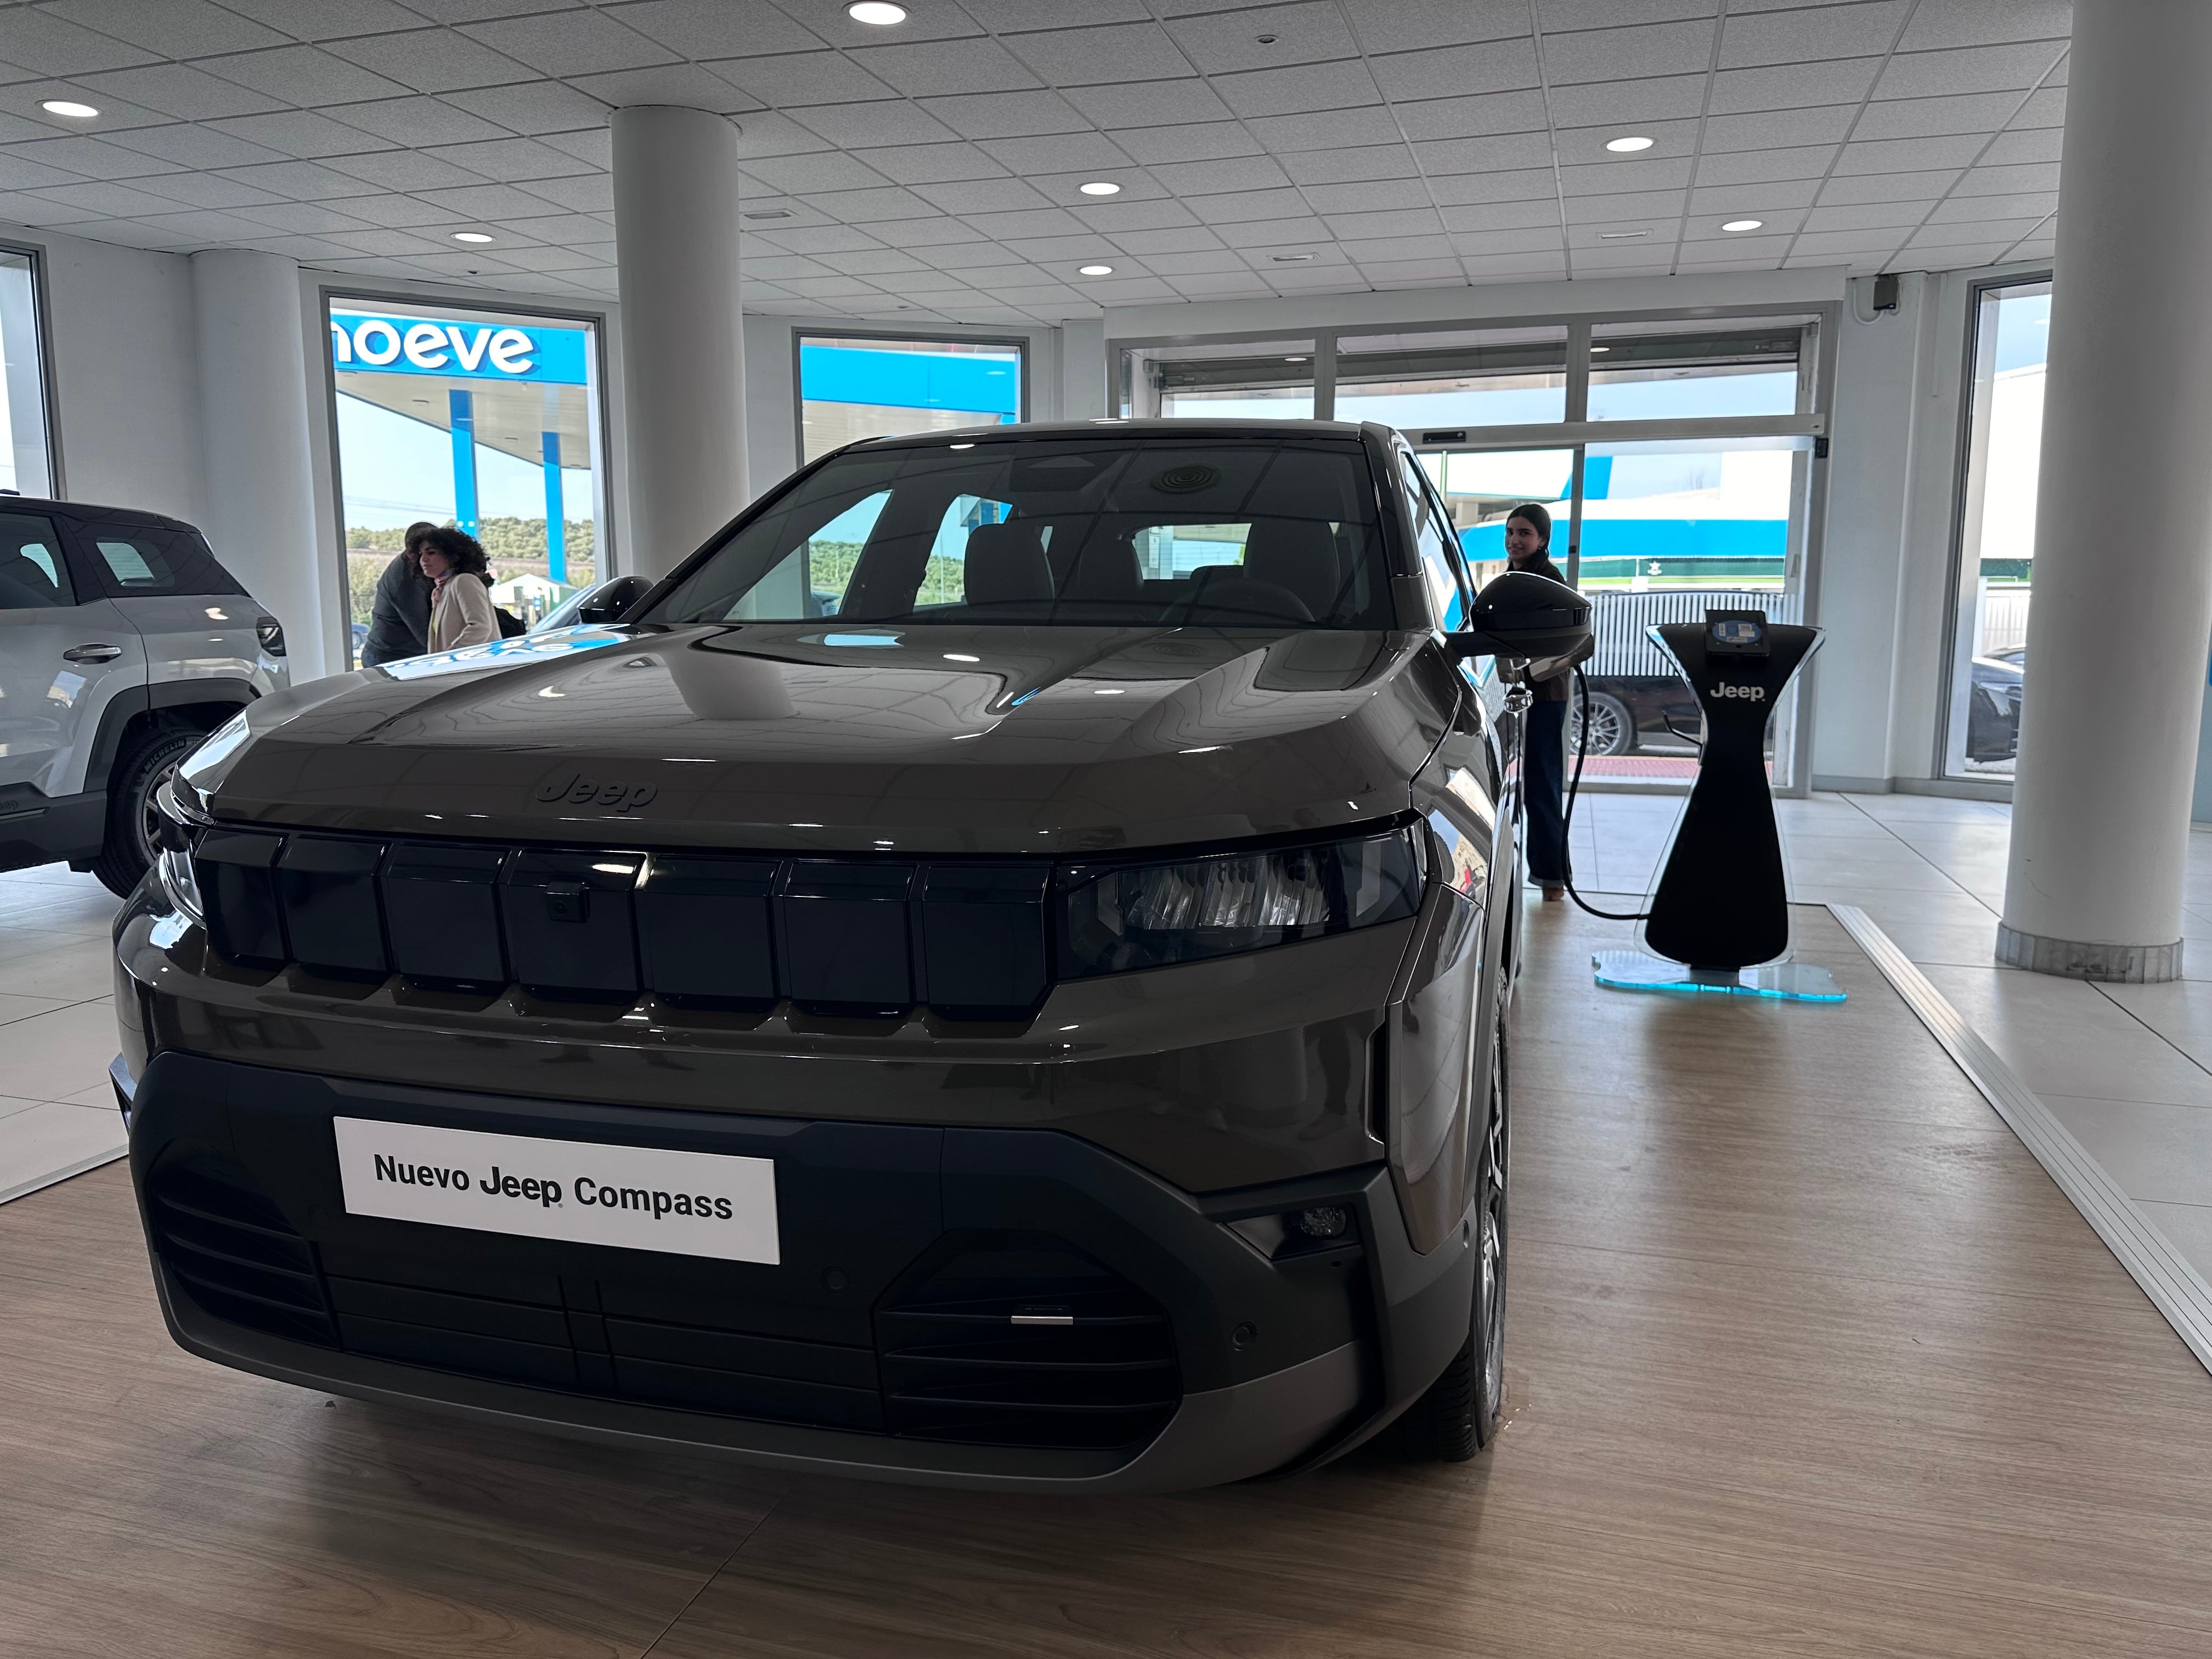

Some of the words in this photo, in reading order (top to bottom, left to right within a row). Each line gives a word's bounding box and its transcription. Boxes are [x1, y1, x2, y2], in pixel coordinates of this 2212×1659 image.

[1709, 681, 1766, 702] Jeep
[144, 738, 185, 772] MICHELIN
[535, 773, 658, 812] Jeep
[374, 1153, 470, 1191] Nuevo
[479, 1166, 563, 1209] Jeep
[574, 1177, 733, 1220] Compass
